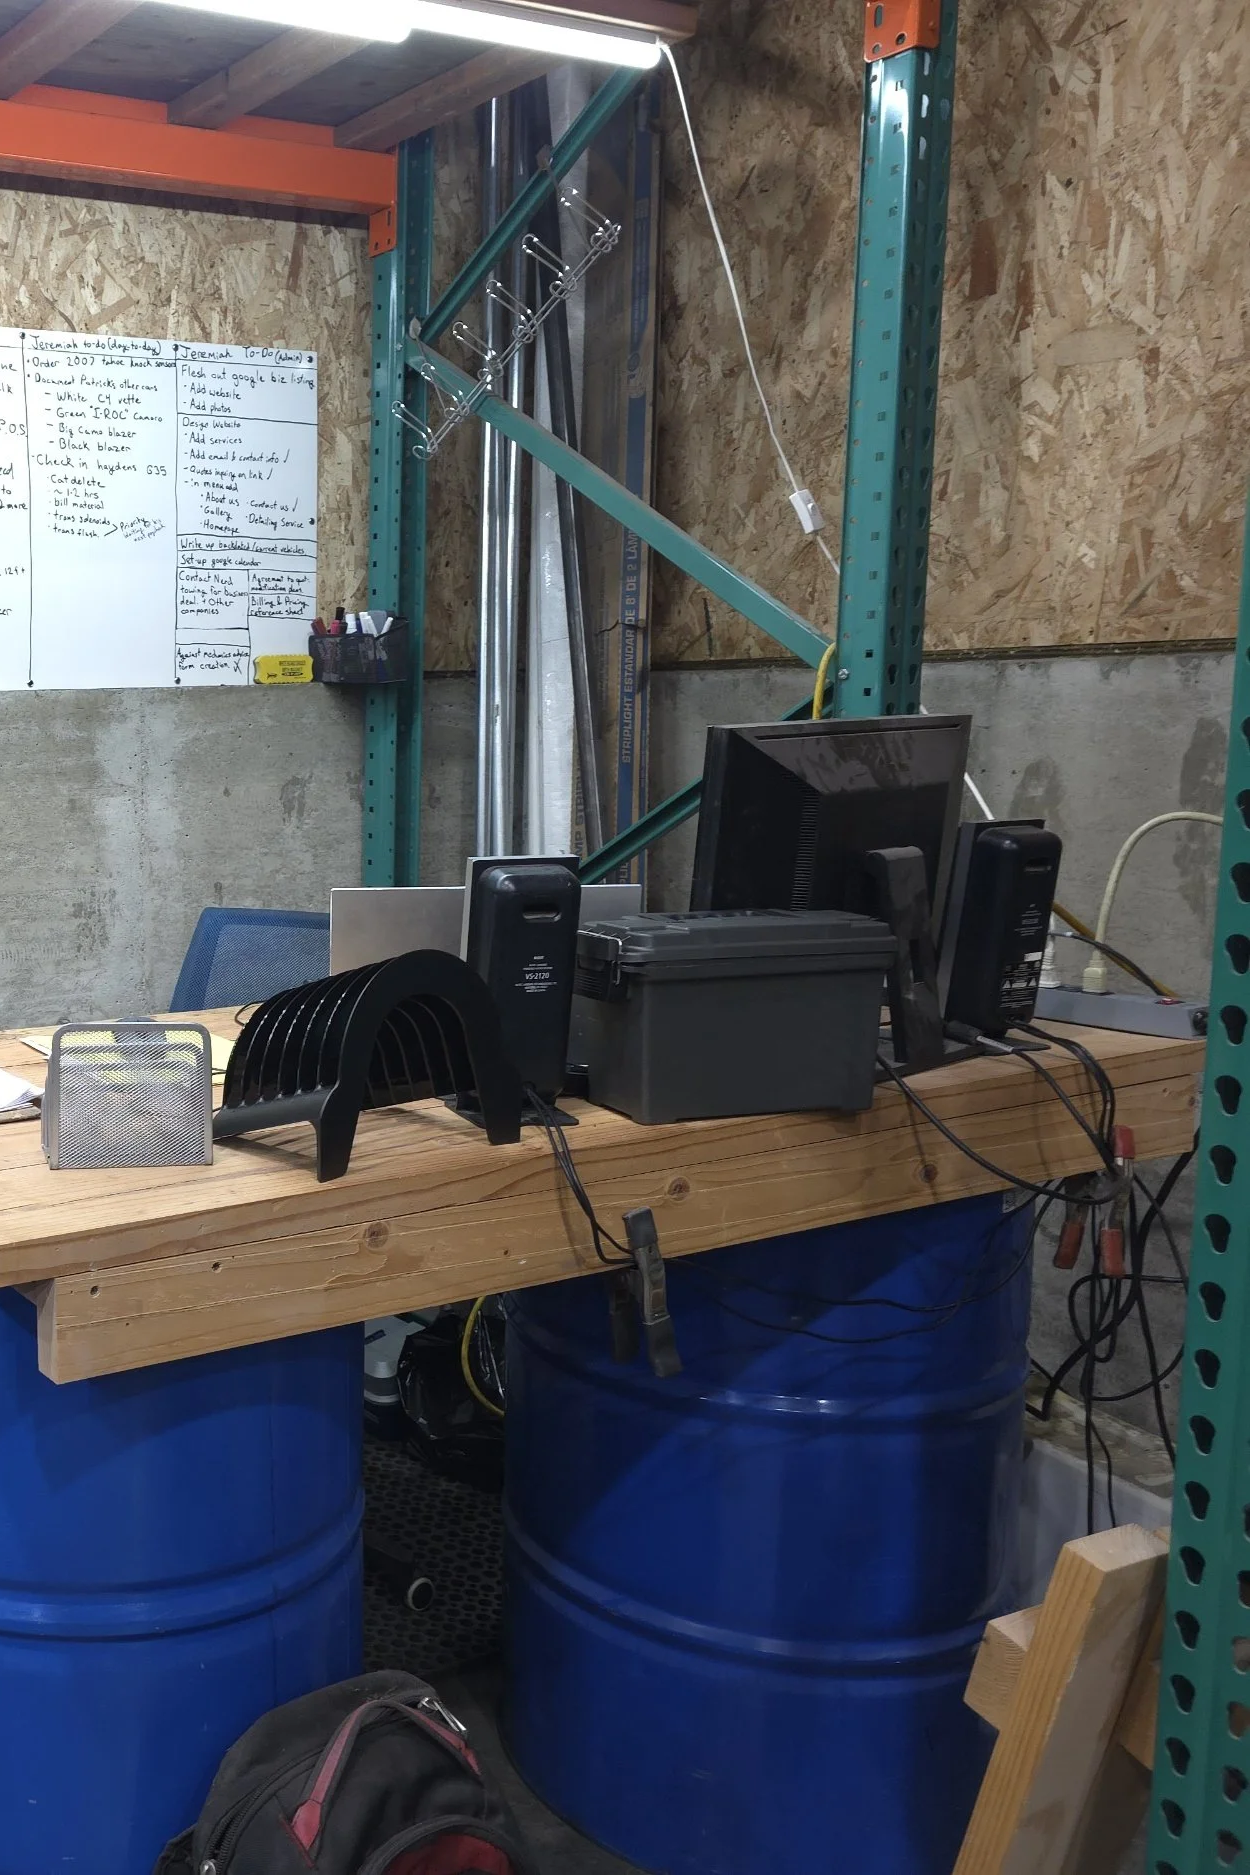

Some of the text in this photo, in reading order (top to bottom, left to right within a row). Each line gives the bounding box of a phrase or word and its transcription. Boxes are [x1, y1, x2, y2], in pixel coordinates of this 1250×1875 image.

[30, 334, 79, 350] Jeremiah
[33, 357, 60, 367] Order
[67, 356, 95, 366] 2007
[181, 364, 315, 389] Flesh out google biz listing
[120, 379, 139, 390] other
[190, 383, 241, 399] Add website
[56, 392, 88, 402] White
[98, 394, 112, 404] C4
[190, 398, 231, 414] Add photos
[56, 408, 86, 418] Green
[59, 423, 73, 438] Big
[108, 428, 136, 438] blazer
[189, 432, 205, 444] Add
[59, 438, 131, 452] Black blazer
[190, 449, 205, 459] Add
[266, 452, 279, 463] info
[36, 454, 167, 476] Check in haydens G35
[51, 475, 105, 488] Cat delete
[204, 481, 224, 489] menu
[1, 484, 11, 494] to
[85, 489, 99, 499] hrs
[54, 498, 68, 506] bill
[205, 492, 239, 506] About us
[204, 506, 232, 522] Gallery
[181, 539, 203, 549] Write
[212, 557, 232, 568] google
[179, 571, 211, 582] Contact
[627, 575, 636, 591] DE
[180, 586, 207, 598] towing
[251, 596, 276, 608] Billing
[625, 609, 636, 625] DE
[624, 630, 635, 694] ESTANDAR
